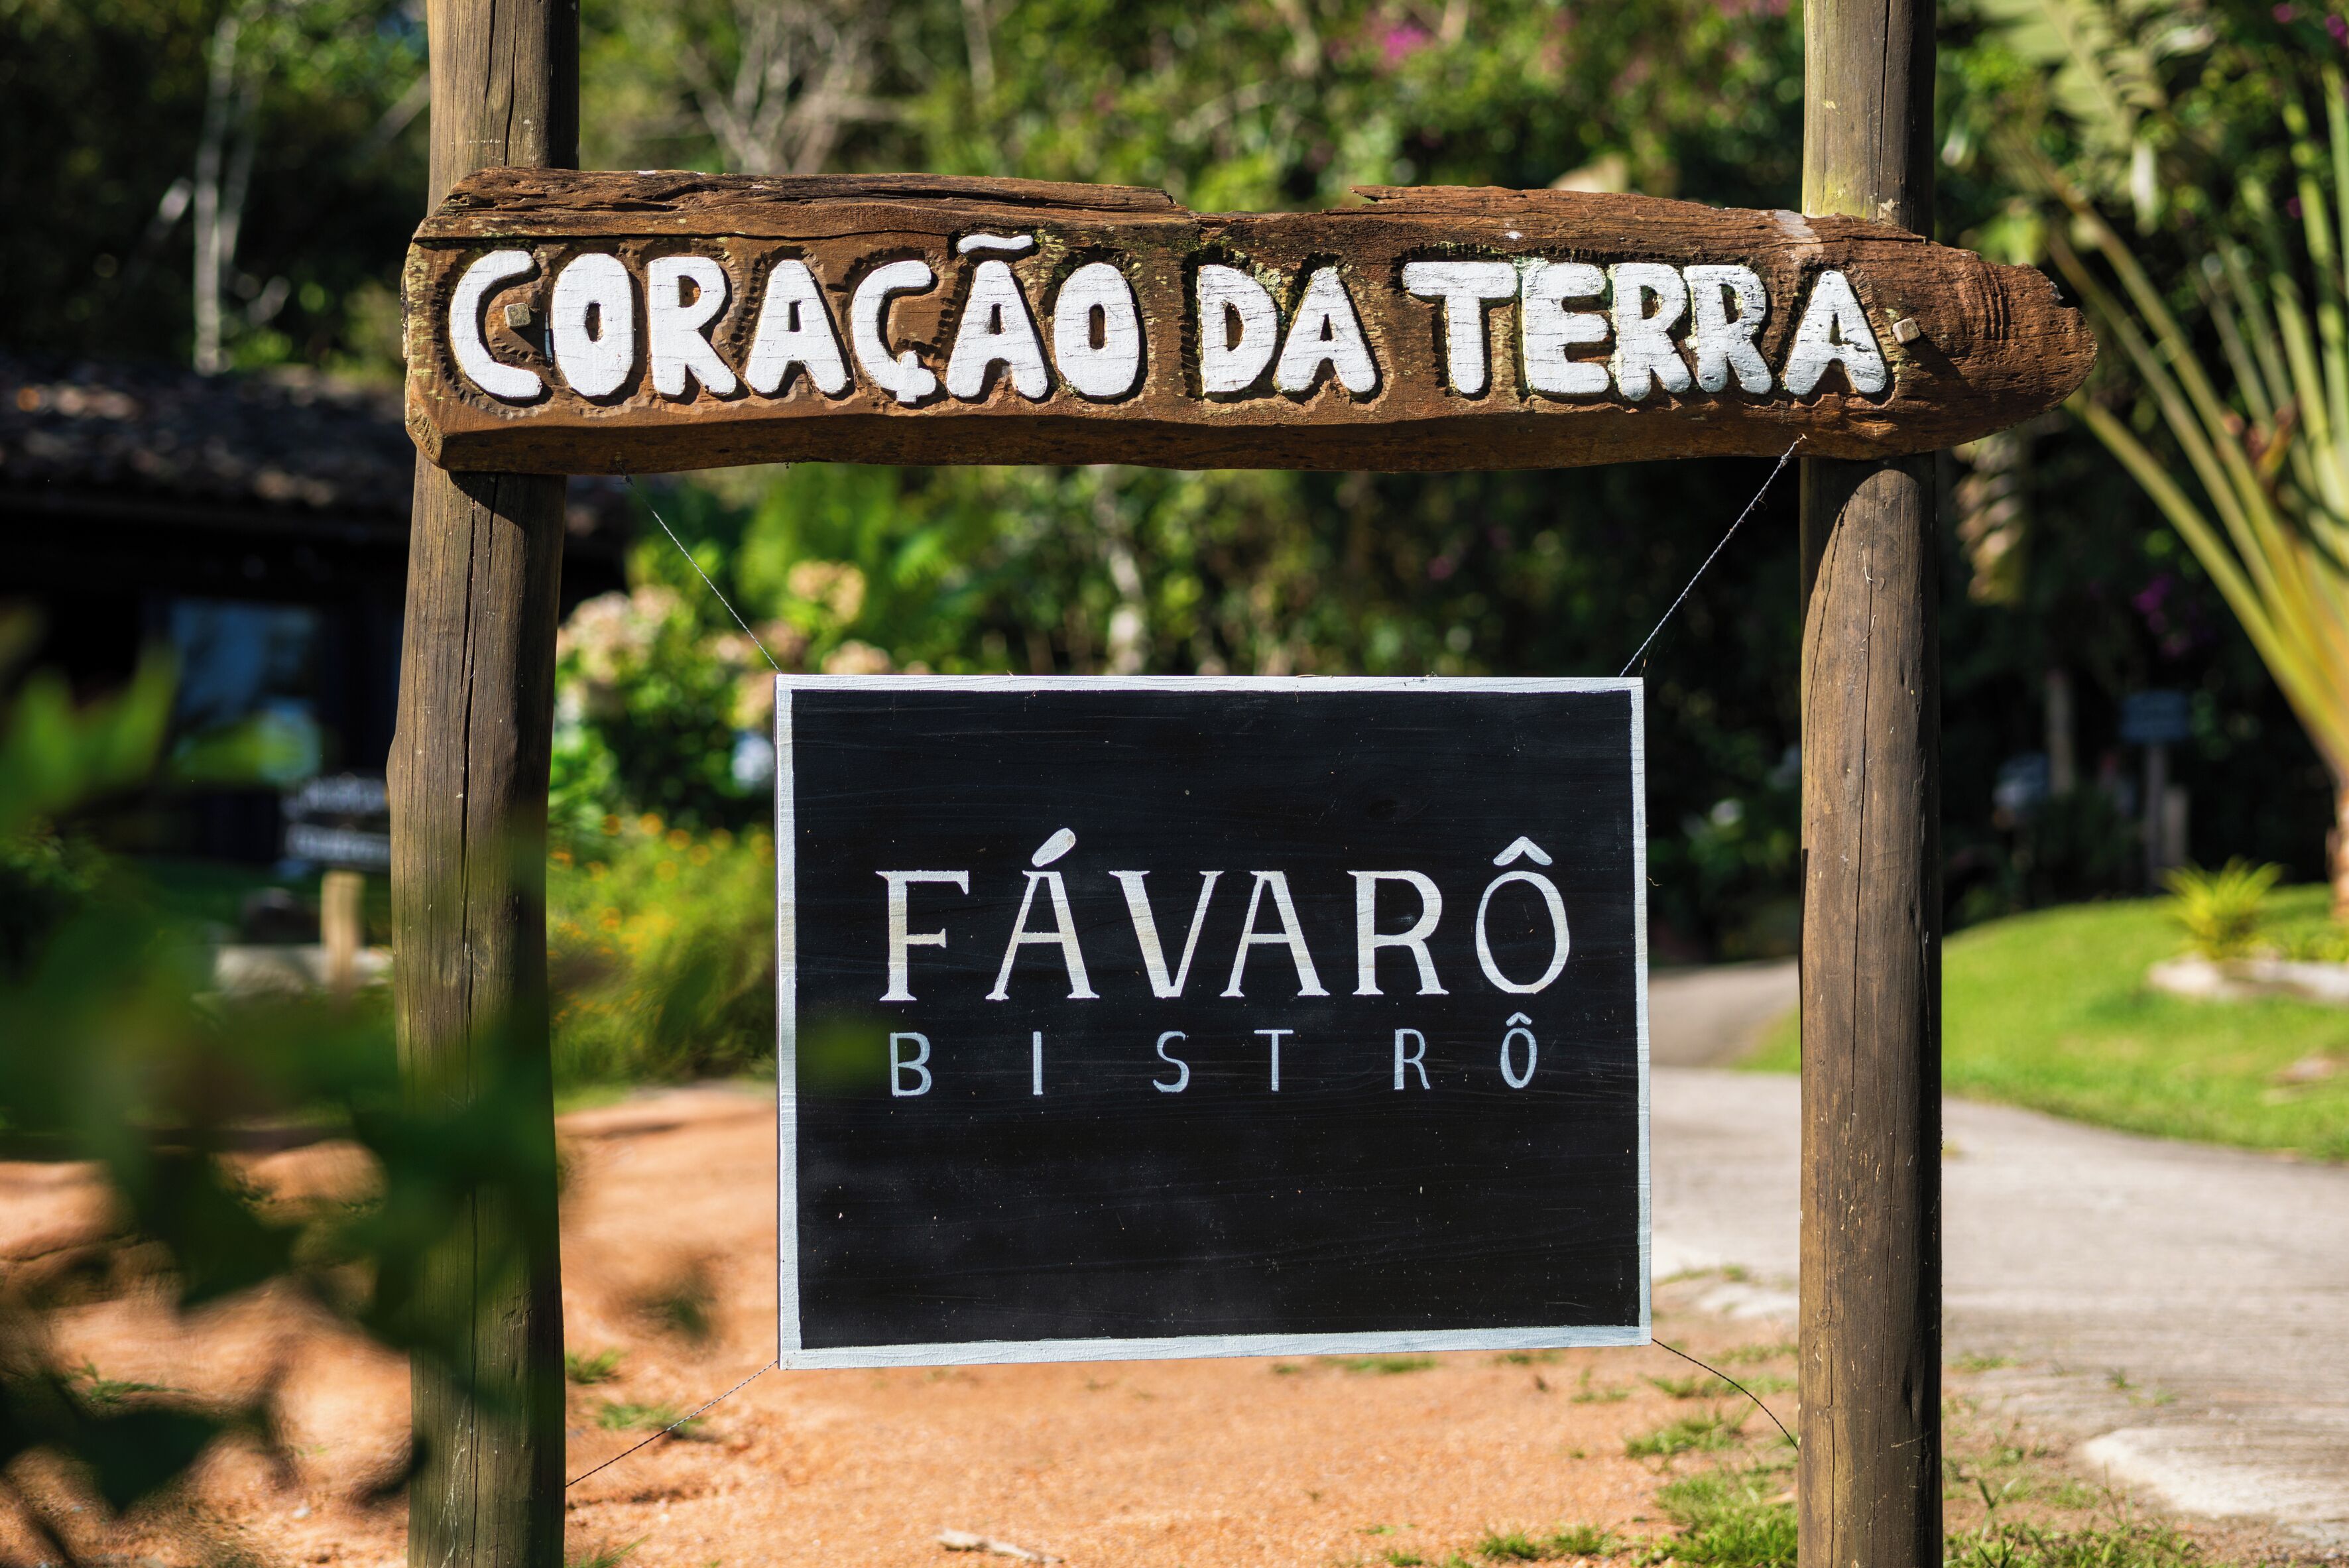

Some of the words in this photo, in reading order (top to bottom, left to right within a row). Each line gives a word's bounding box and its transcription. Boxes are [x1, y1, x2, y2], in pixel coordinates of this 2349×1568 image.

[447, 232, 1141, 404] CORAÇÃO
[1195, 263, 1378, 396] DA
[1402, 258, 1886, 398] TERRA
[874, 827, 1571, 1001] FÁVARÔ
[889, 1012, 1537, 1097] BISTRÔ
